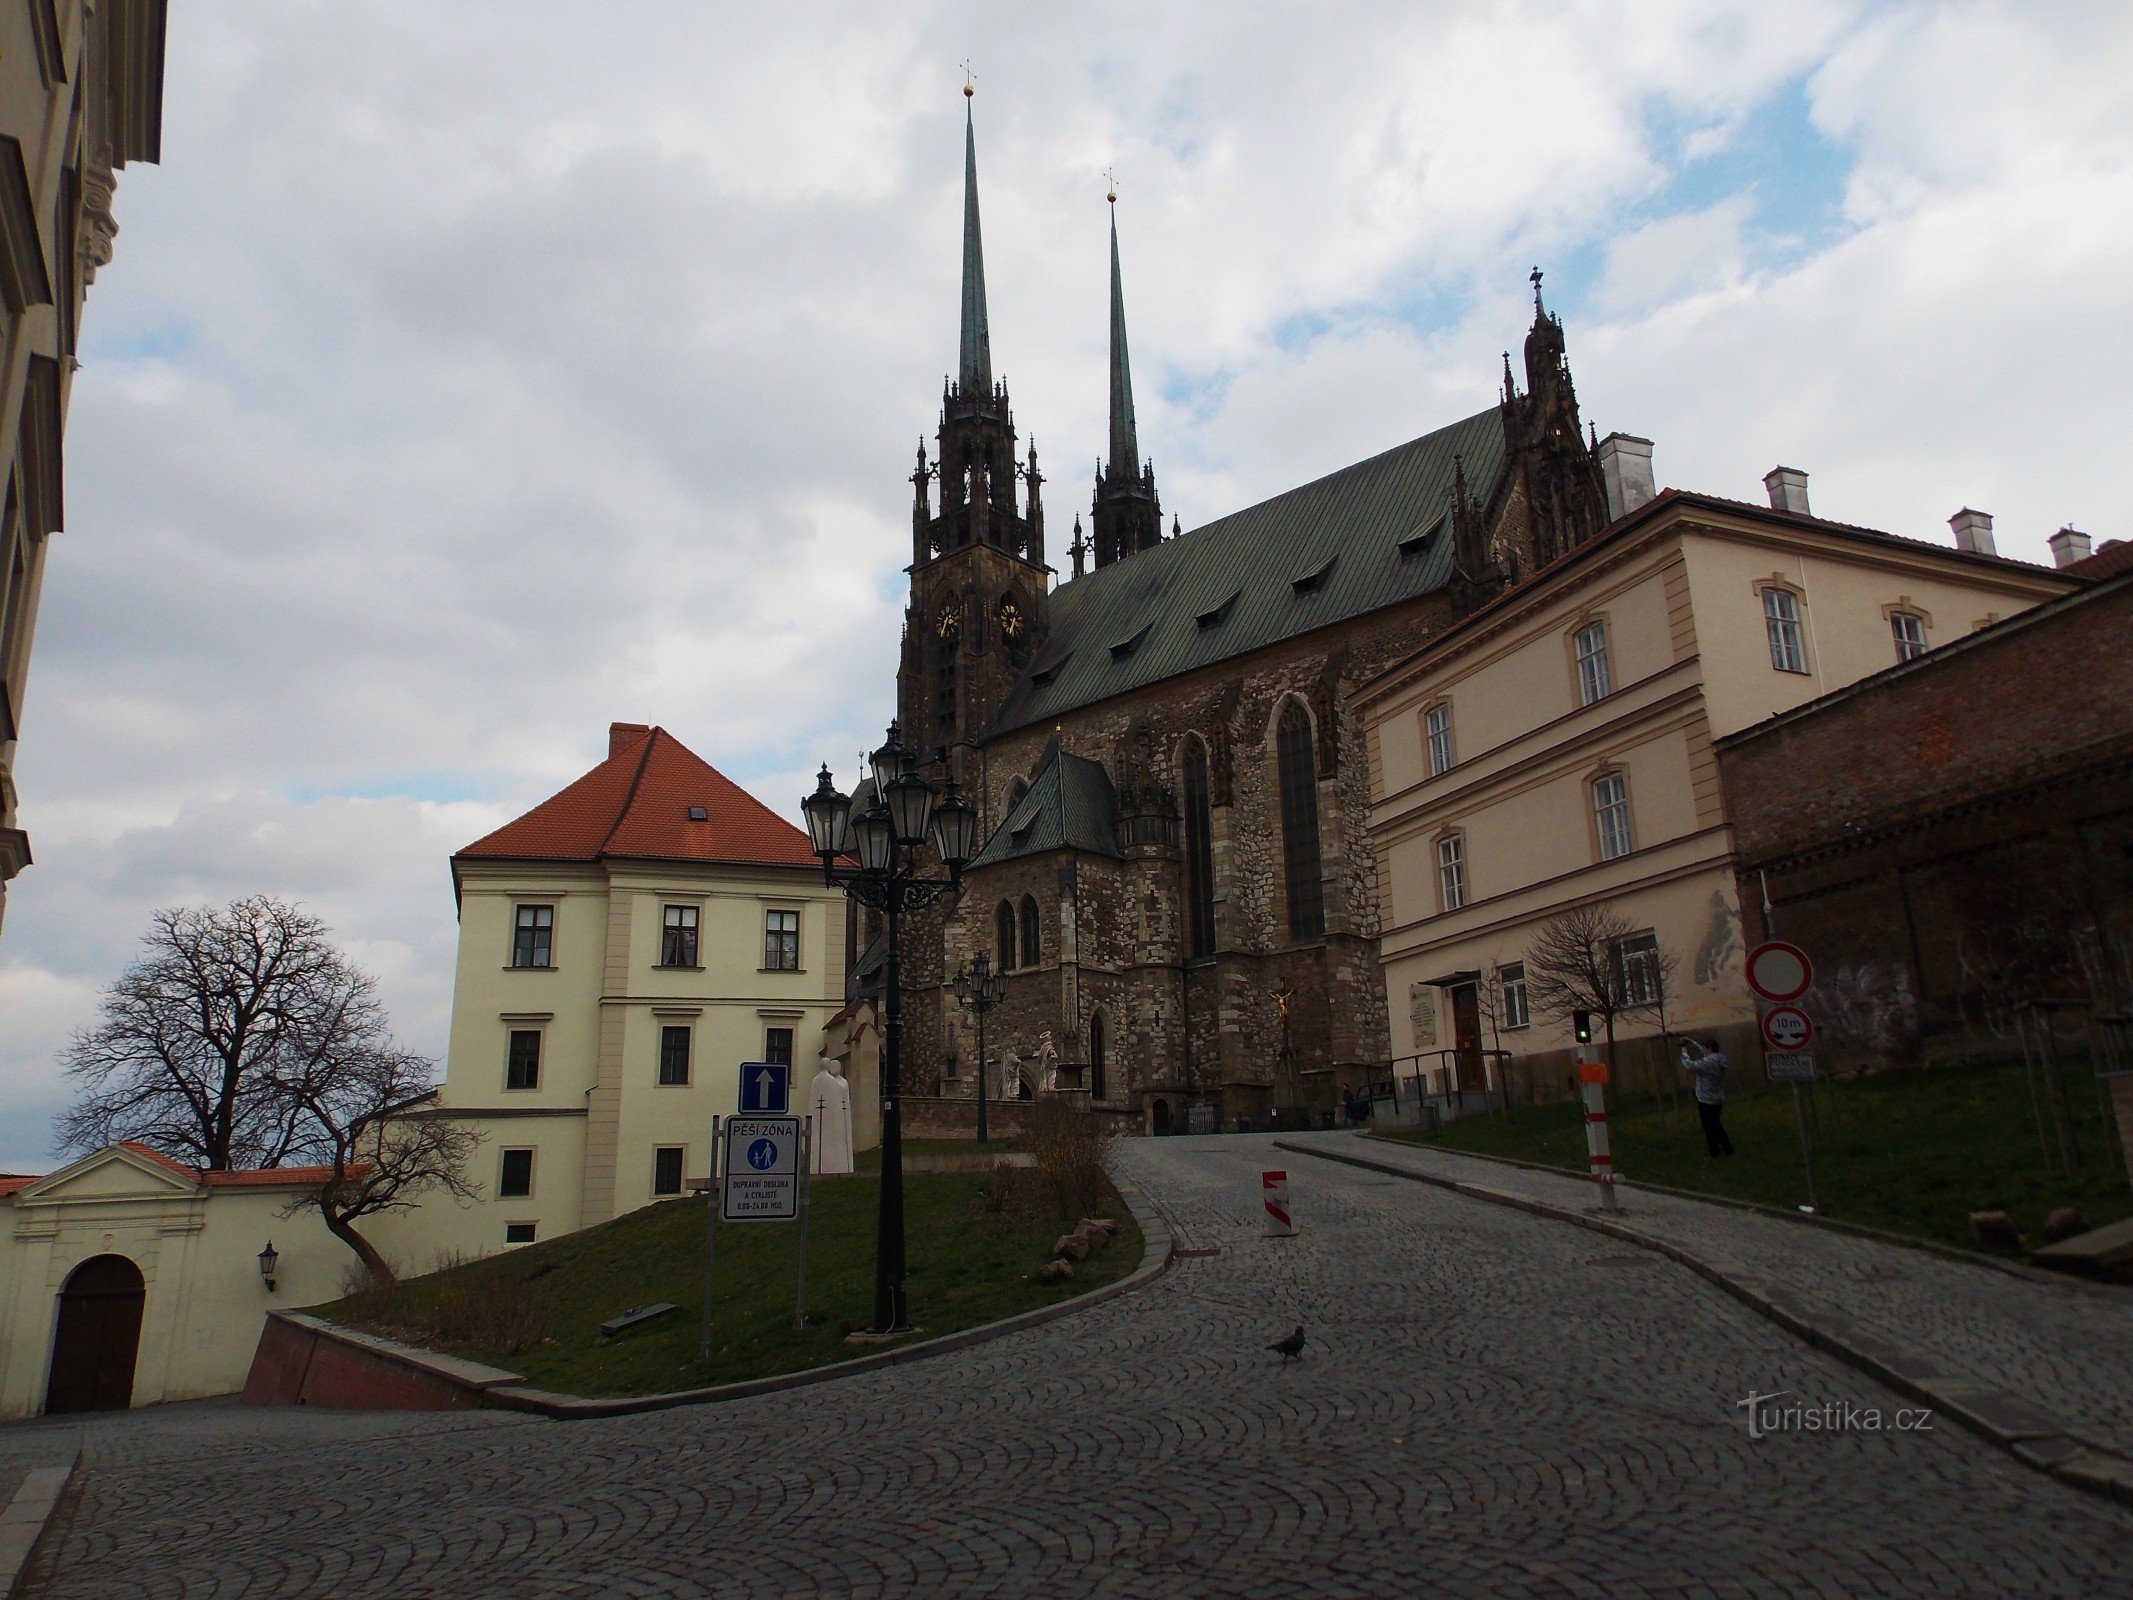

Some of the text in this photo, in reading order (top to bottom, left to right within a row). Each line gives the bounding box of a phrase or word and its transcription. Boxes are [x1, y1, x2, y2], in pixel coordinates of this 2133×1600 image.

[1777, 1018, 1801, 1028] 10 m
[733, 1123, 793, 1136] PĚŠÍ ZÓNA
[733, 1179, 761, 1189] DOPRAVNÍ
